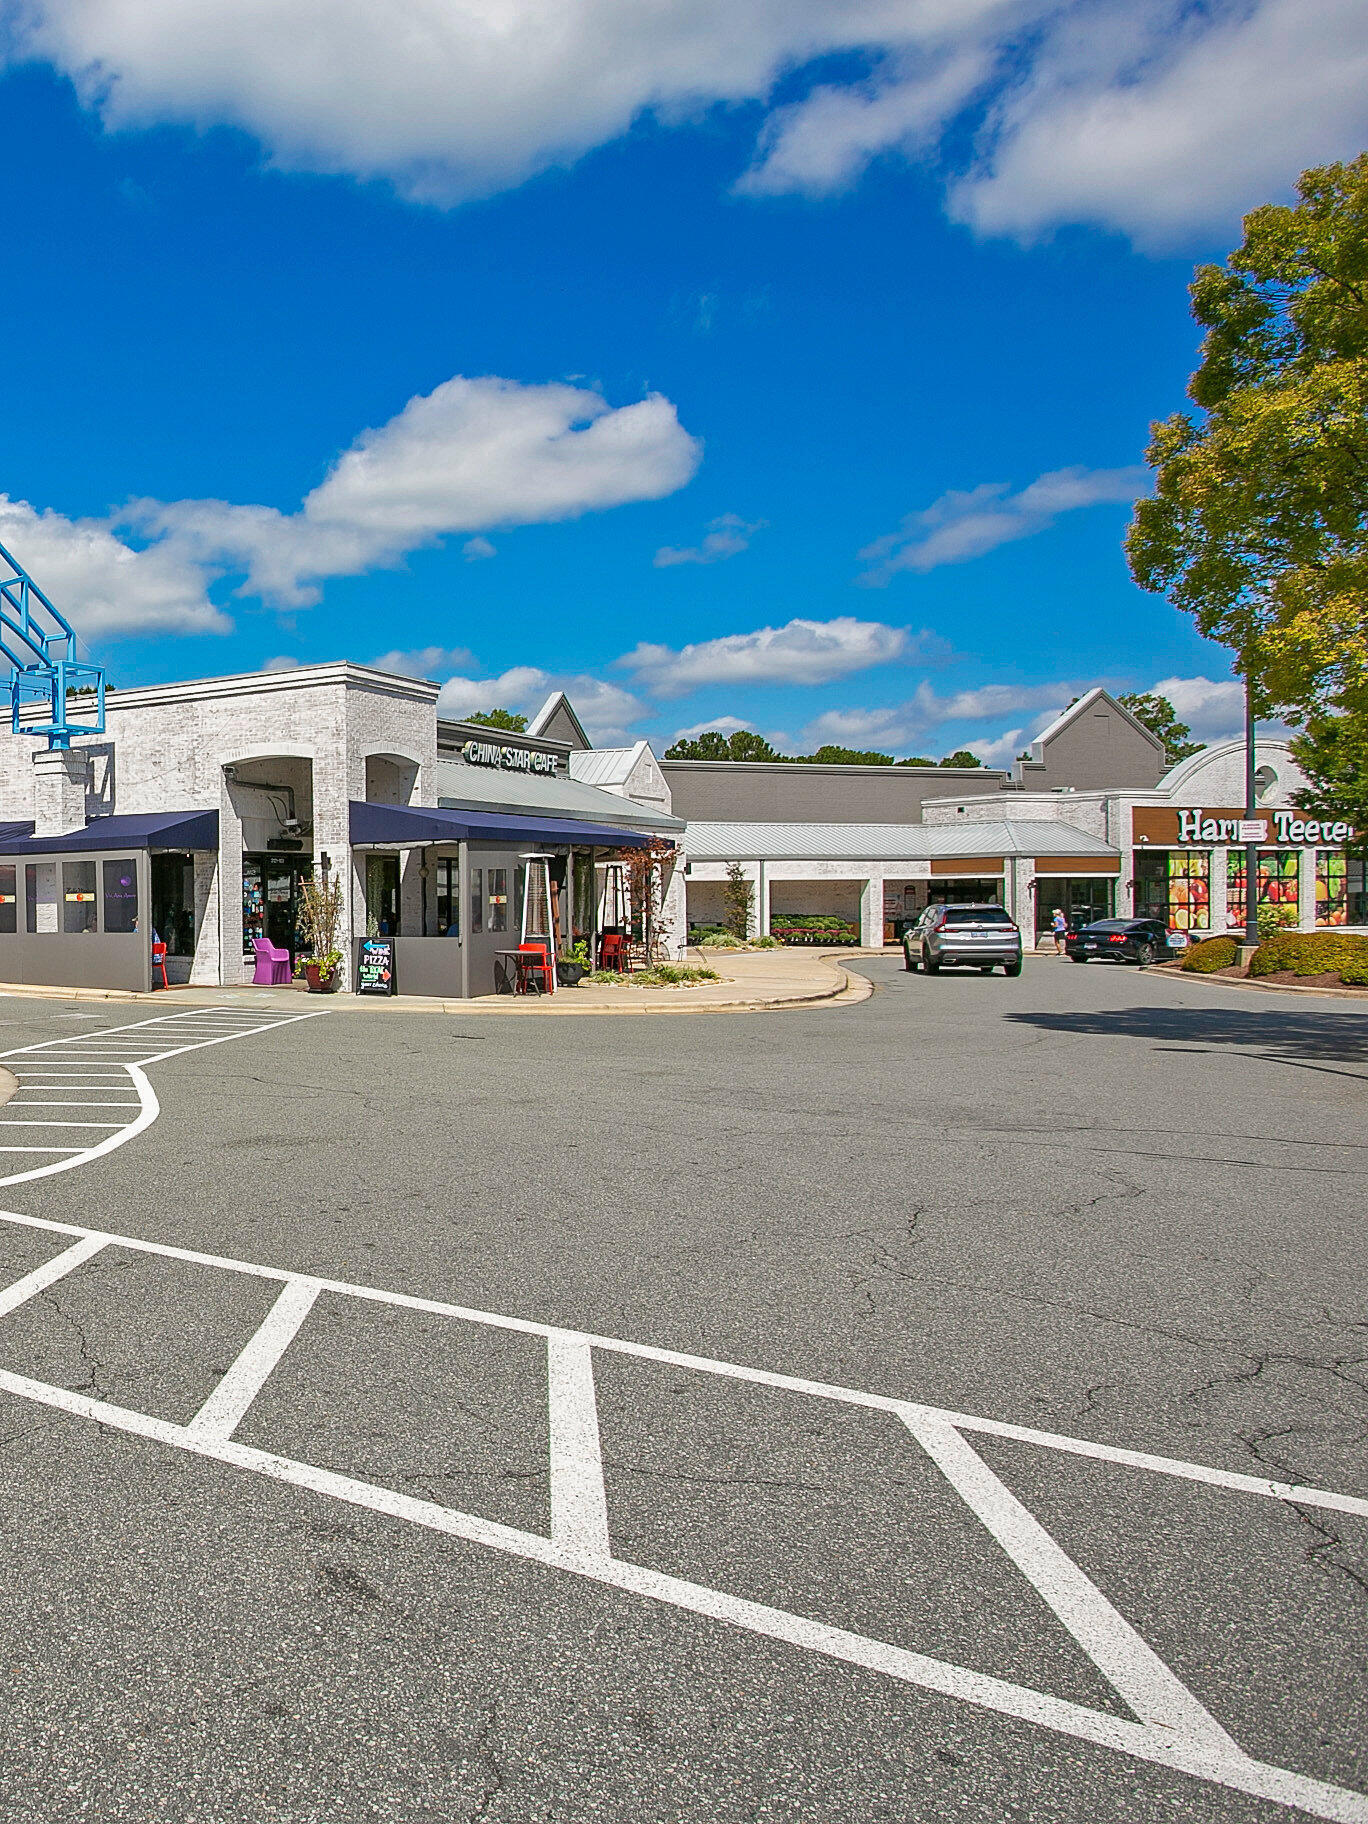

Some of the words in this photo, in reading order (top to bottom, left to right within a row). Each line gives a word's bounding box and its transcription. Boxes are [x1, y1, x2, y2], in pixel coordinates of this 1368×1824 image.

[468, 741, 502, 765] CHINA
[505, 747, 531, 769] STAR
[534, 752, 559, 772] CAFE
[363, 955, 389, 965] PIZZA
